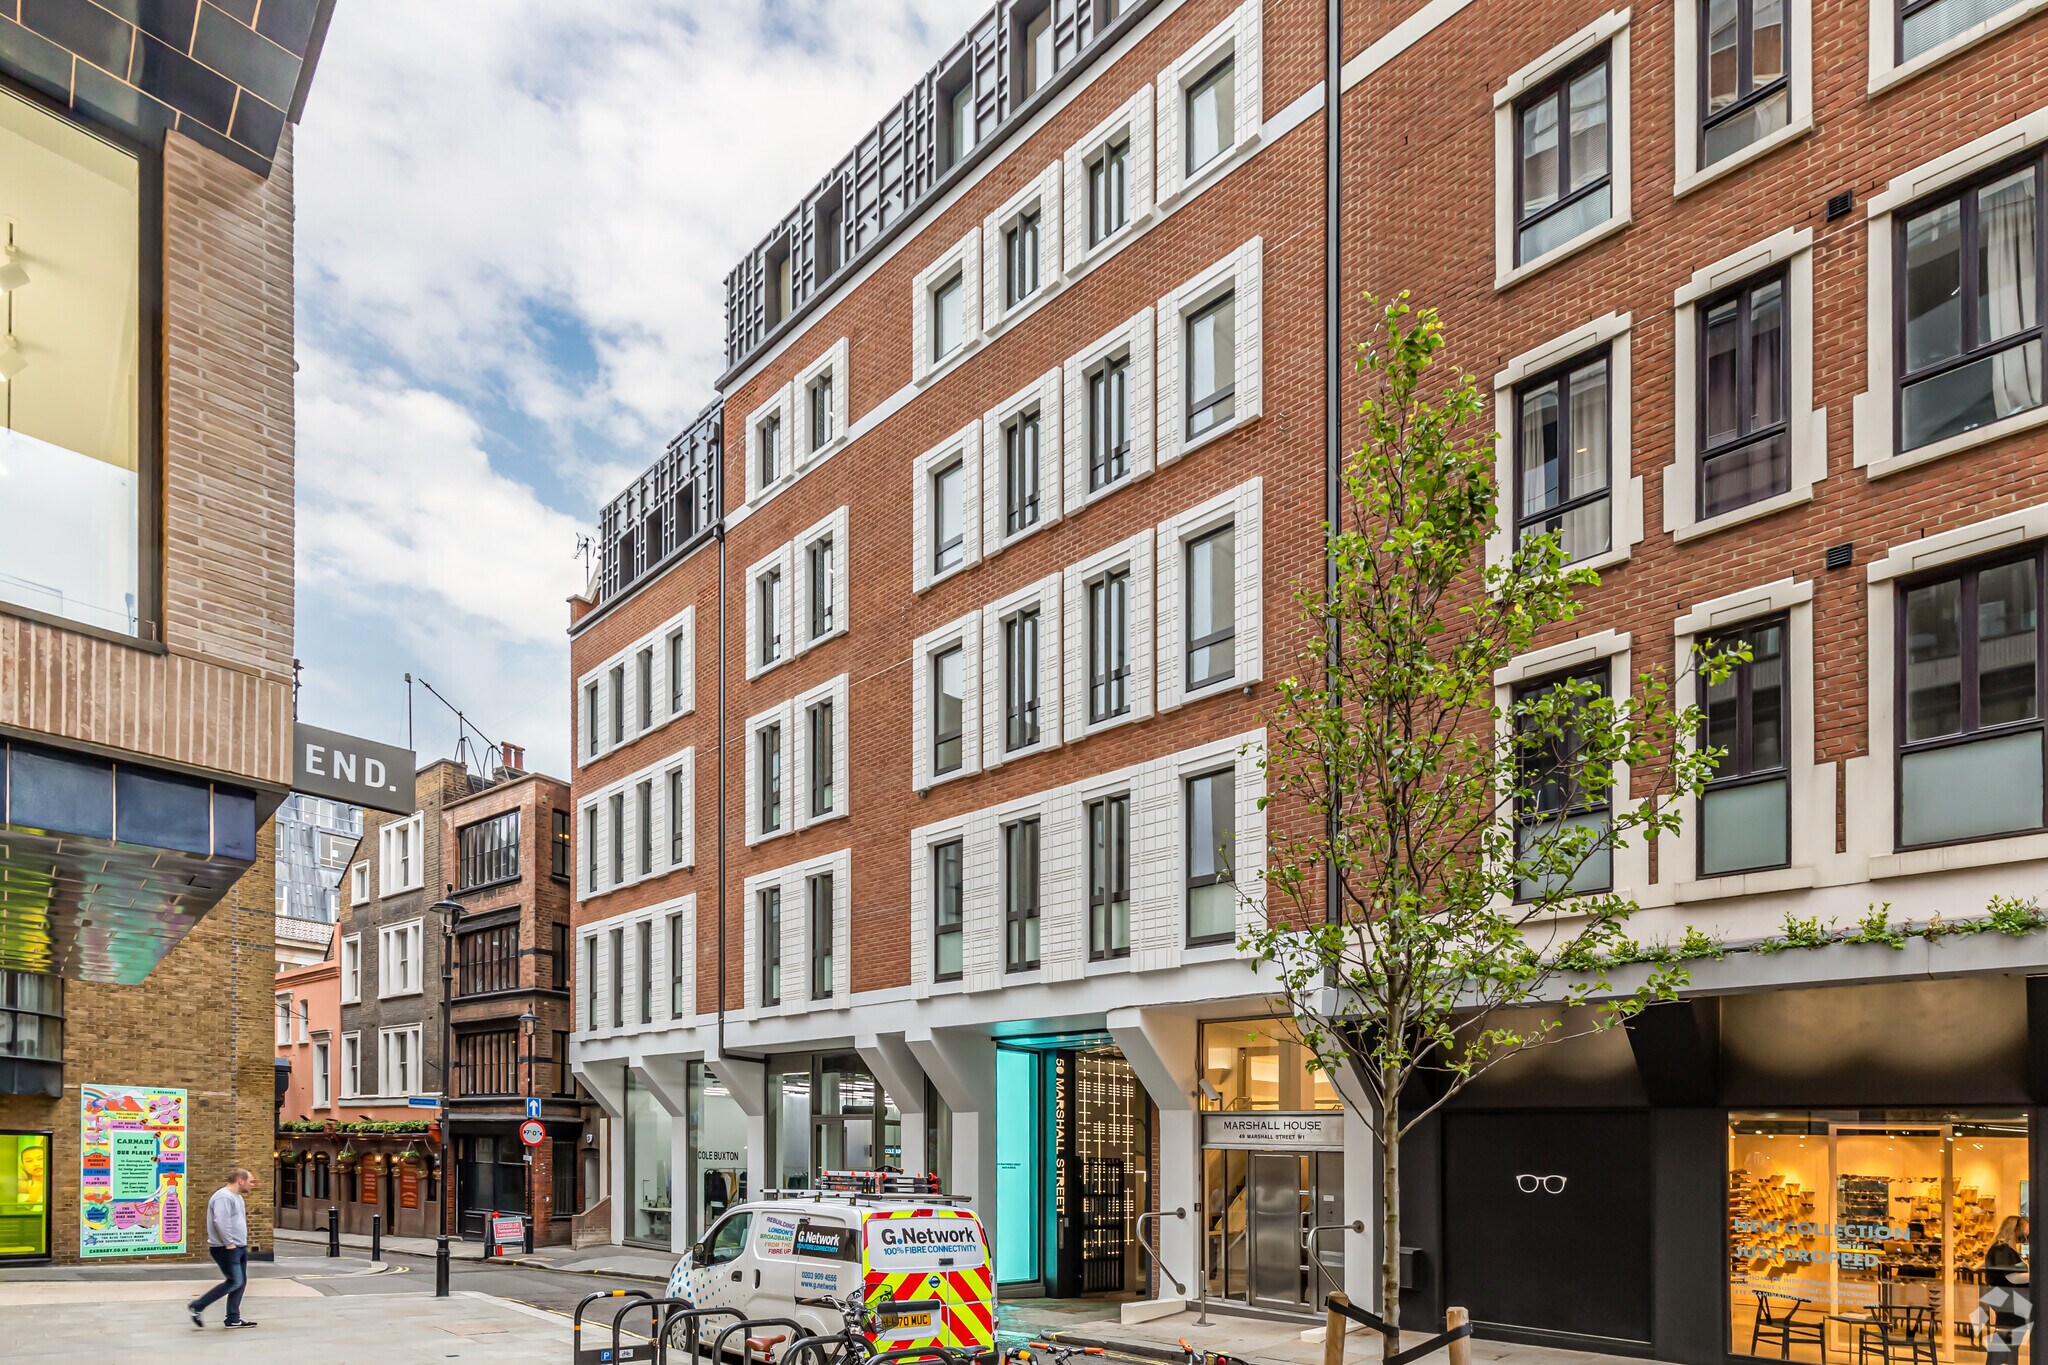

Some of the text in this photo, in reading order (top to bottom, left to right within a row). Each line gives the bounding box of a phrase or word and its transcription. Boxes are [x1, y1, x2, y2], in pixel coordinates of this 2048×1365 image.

[305, 743, 397, 792] END.
[1056, 1078, 1065, 1154] MARSHALL
[1223, 1121, 1322, 1130] MARSHALL HOUSE
[698, 1151, 739, 1160] COLE BUXTON
[1056, 1158, 1065, 1215] STREET
[767, 1217, 795, 1230] REBUILDING
[768, 1227, 794, 1236] LONDON'S
[1734, 1218, 1911, 1241] NEW COLLECTION
[760, 1233, 793, 1242] BROADBAND
[798, 1230, 840, 1246] G.Network
[881, 1227, 976, 1245] G.Network
[814, 1245, 838, 1253] CONNECTIVITY
[884, 1244, 977, 1256] 100% FIBRE CONNECTIVITY
[1734, 1245, 1879, 1268] JUST DROPPED
[801, 1271, 814, 1279] 0203
[800, 1281, 837, 1291] www.g.network
[1734, 1282, 1775, 1290] HANDMADE
[911, 1315, 928, 1325] MUC
[603, 1352, 610, 1360] P
